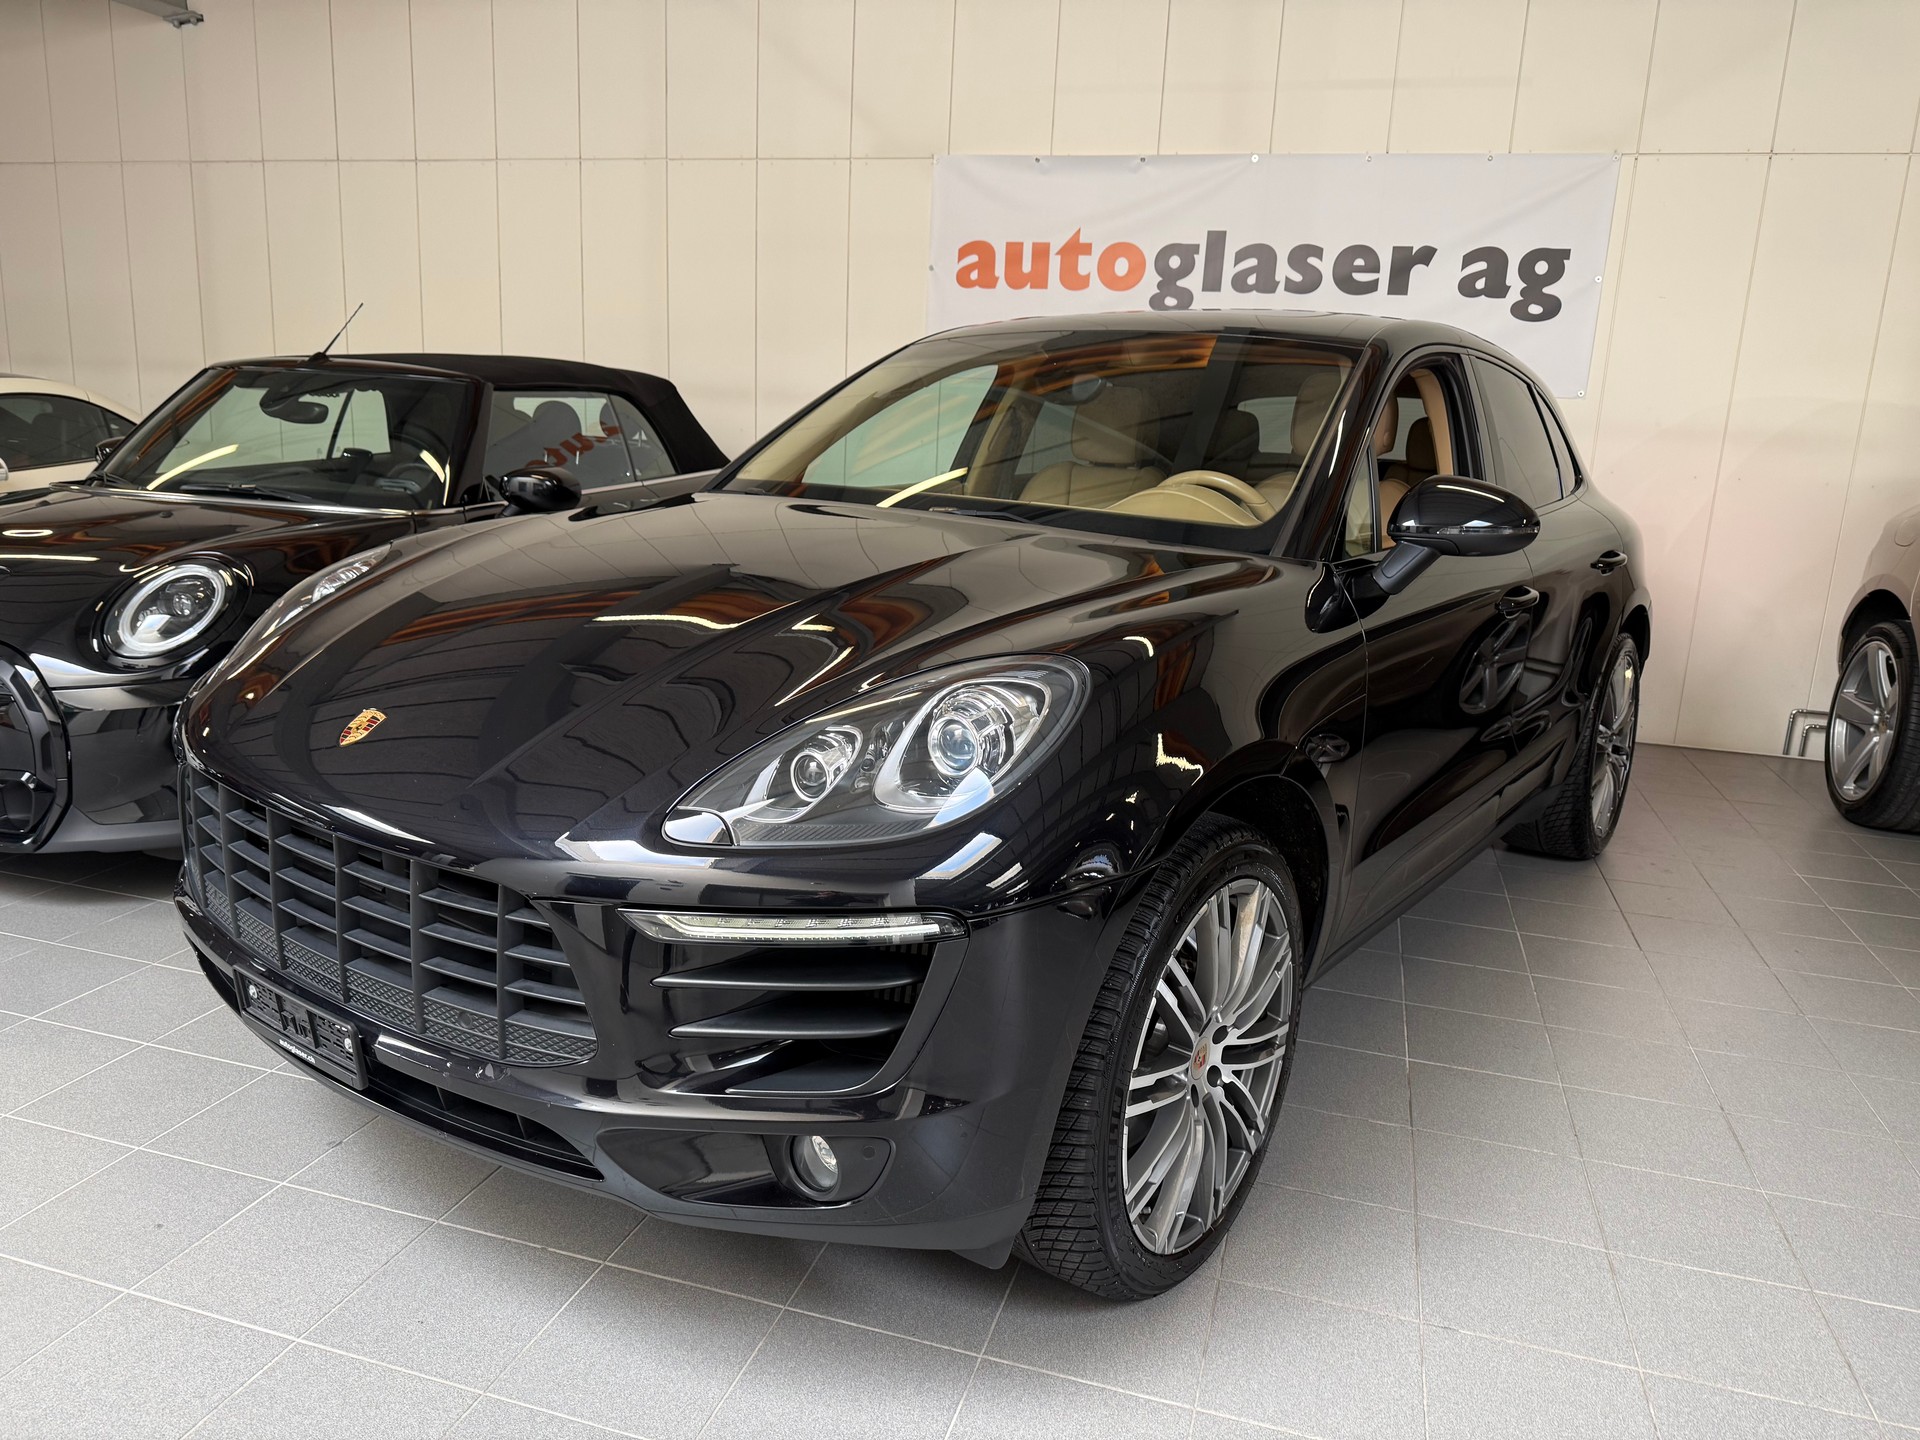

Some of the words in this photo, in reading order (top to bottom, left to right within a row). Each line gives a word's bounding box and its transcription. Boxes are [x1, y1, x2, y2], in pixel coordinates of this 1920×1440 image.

[956, 229, 1437, 311] autoglaser
[1457, 247, 1571, 322] ag
[1108, 1096, 1122, 1219] MICHELIN
